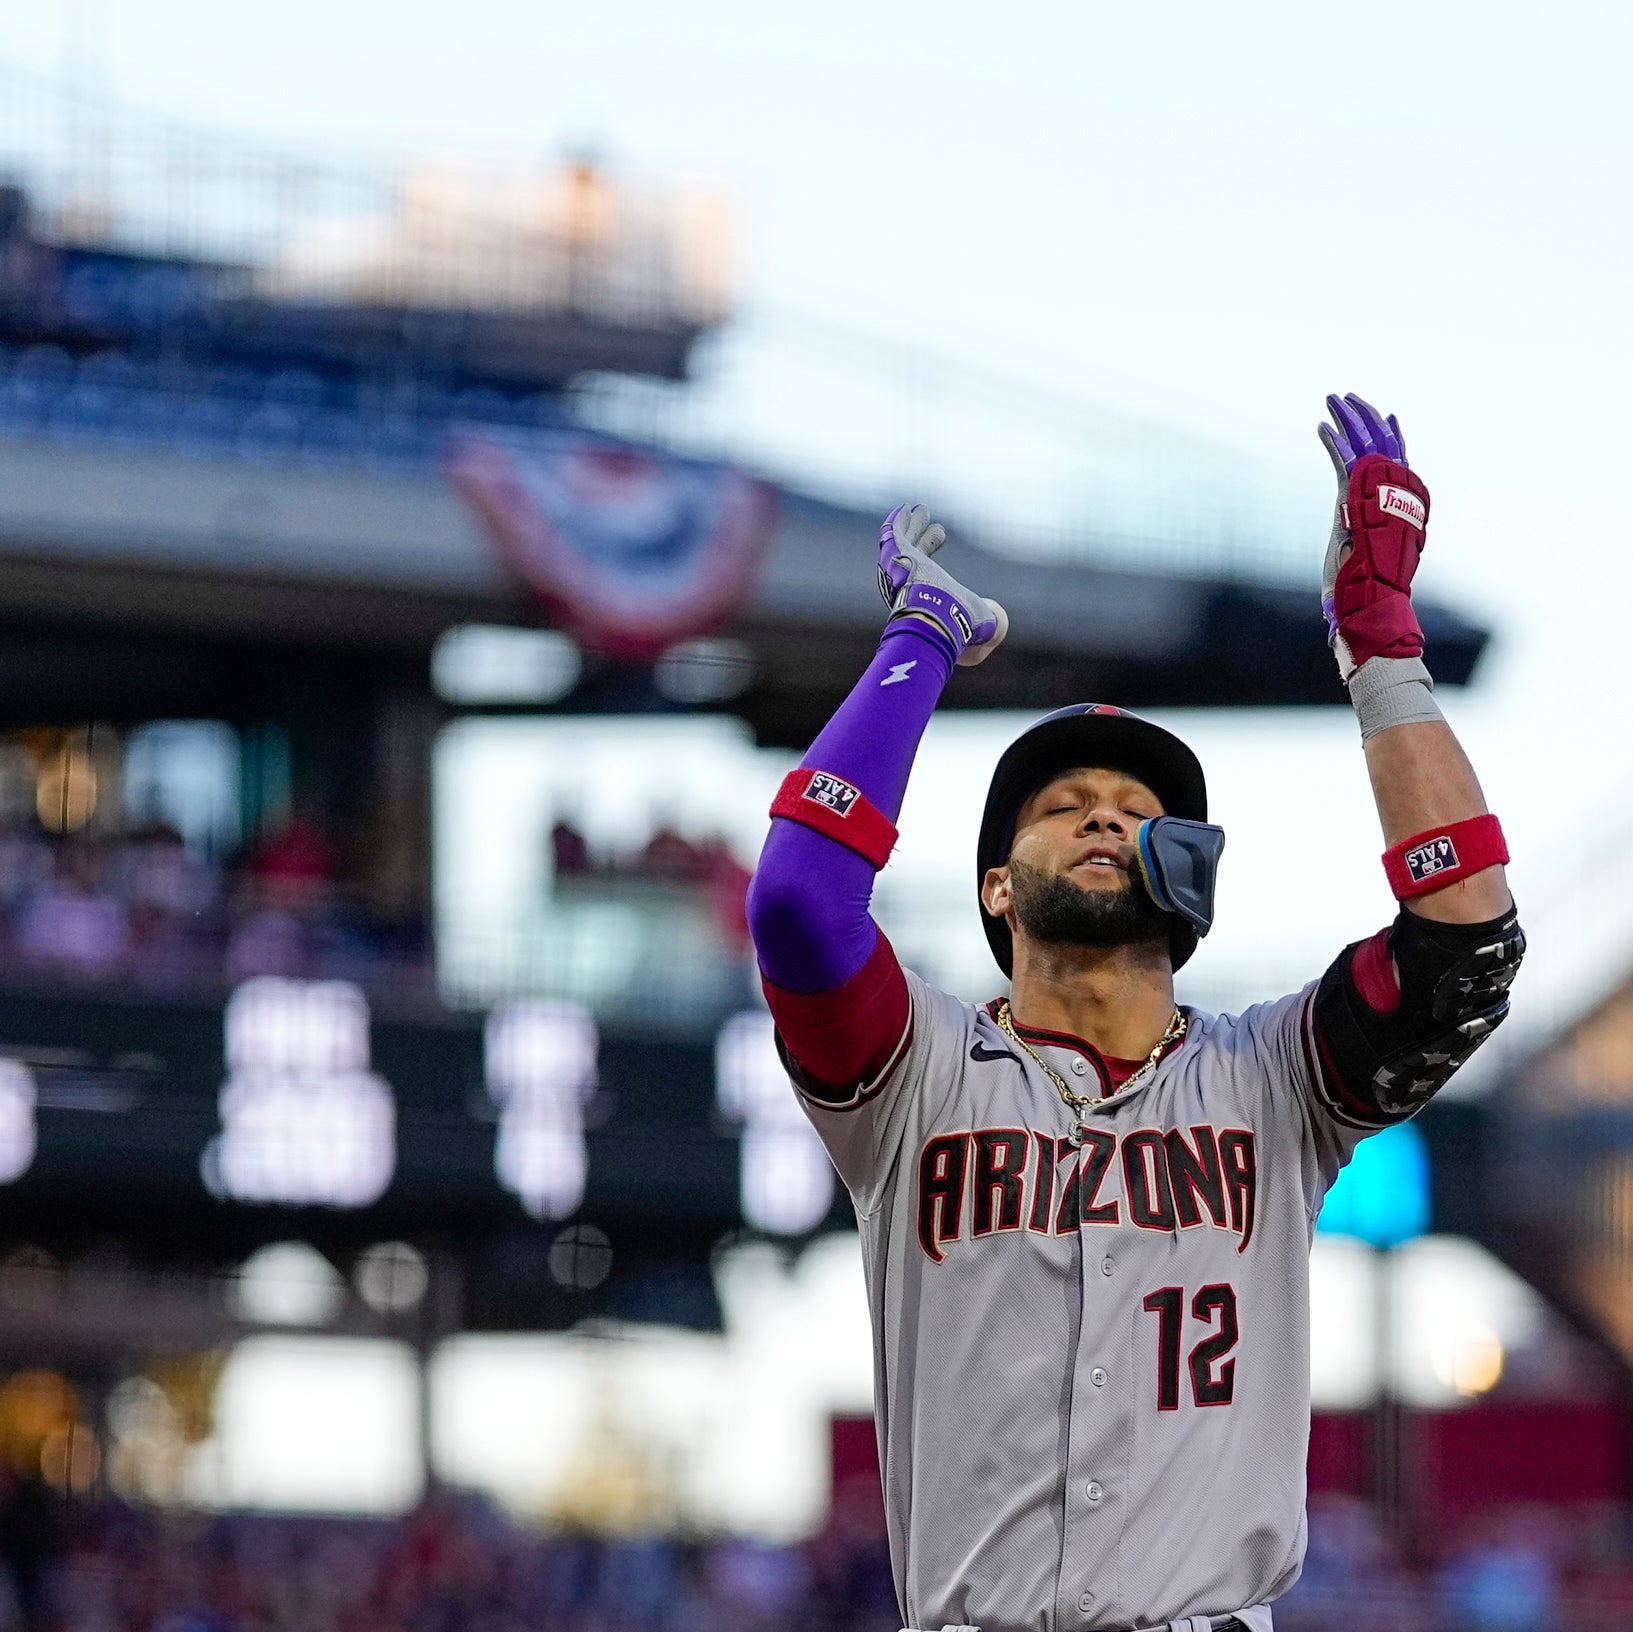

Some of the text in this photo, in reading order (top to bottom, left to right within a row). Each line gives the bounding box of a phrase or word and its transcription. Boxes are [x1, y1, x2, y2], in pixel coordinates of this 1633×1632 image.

[920, 592, 942, 605] LG-12
[814, 776, 854, 801] 4 ALS
[1409, 841, 1449, 867] 4 ALS
[918, 1124, 1256, 1264] ARIZONA
[1143, 1282, 1240, 1412] 12
